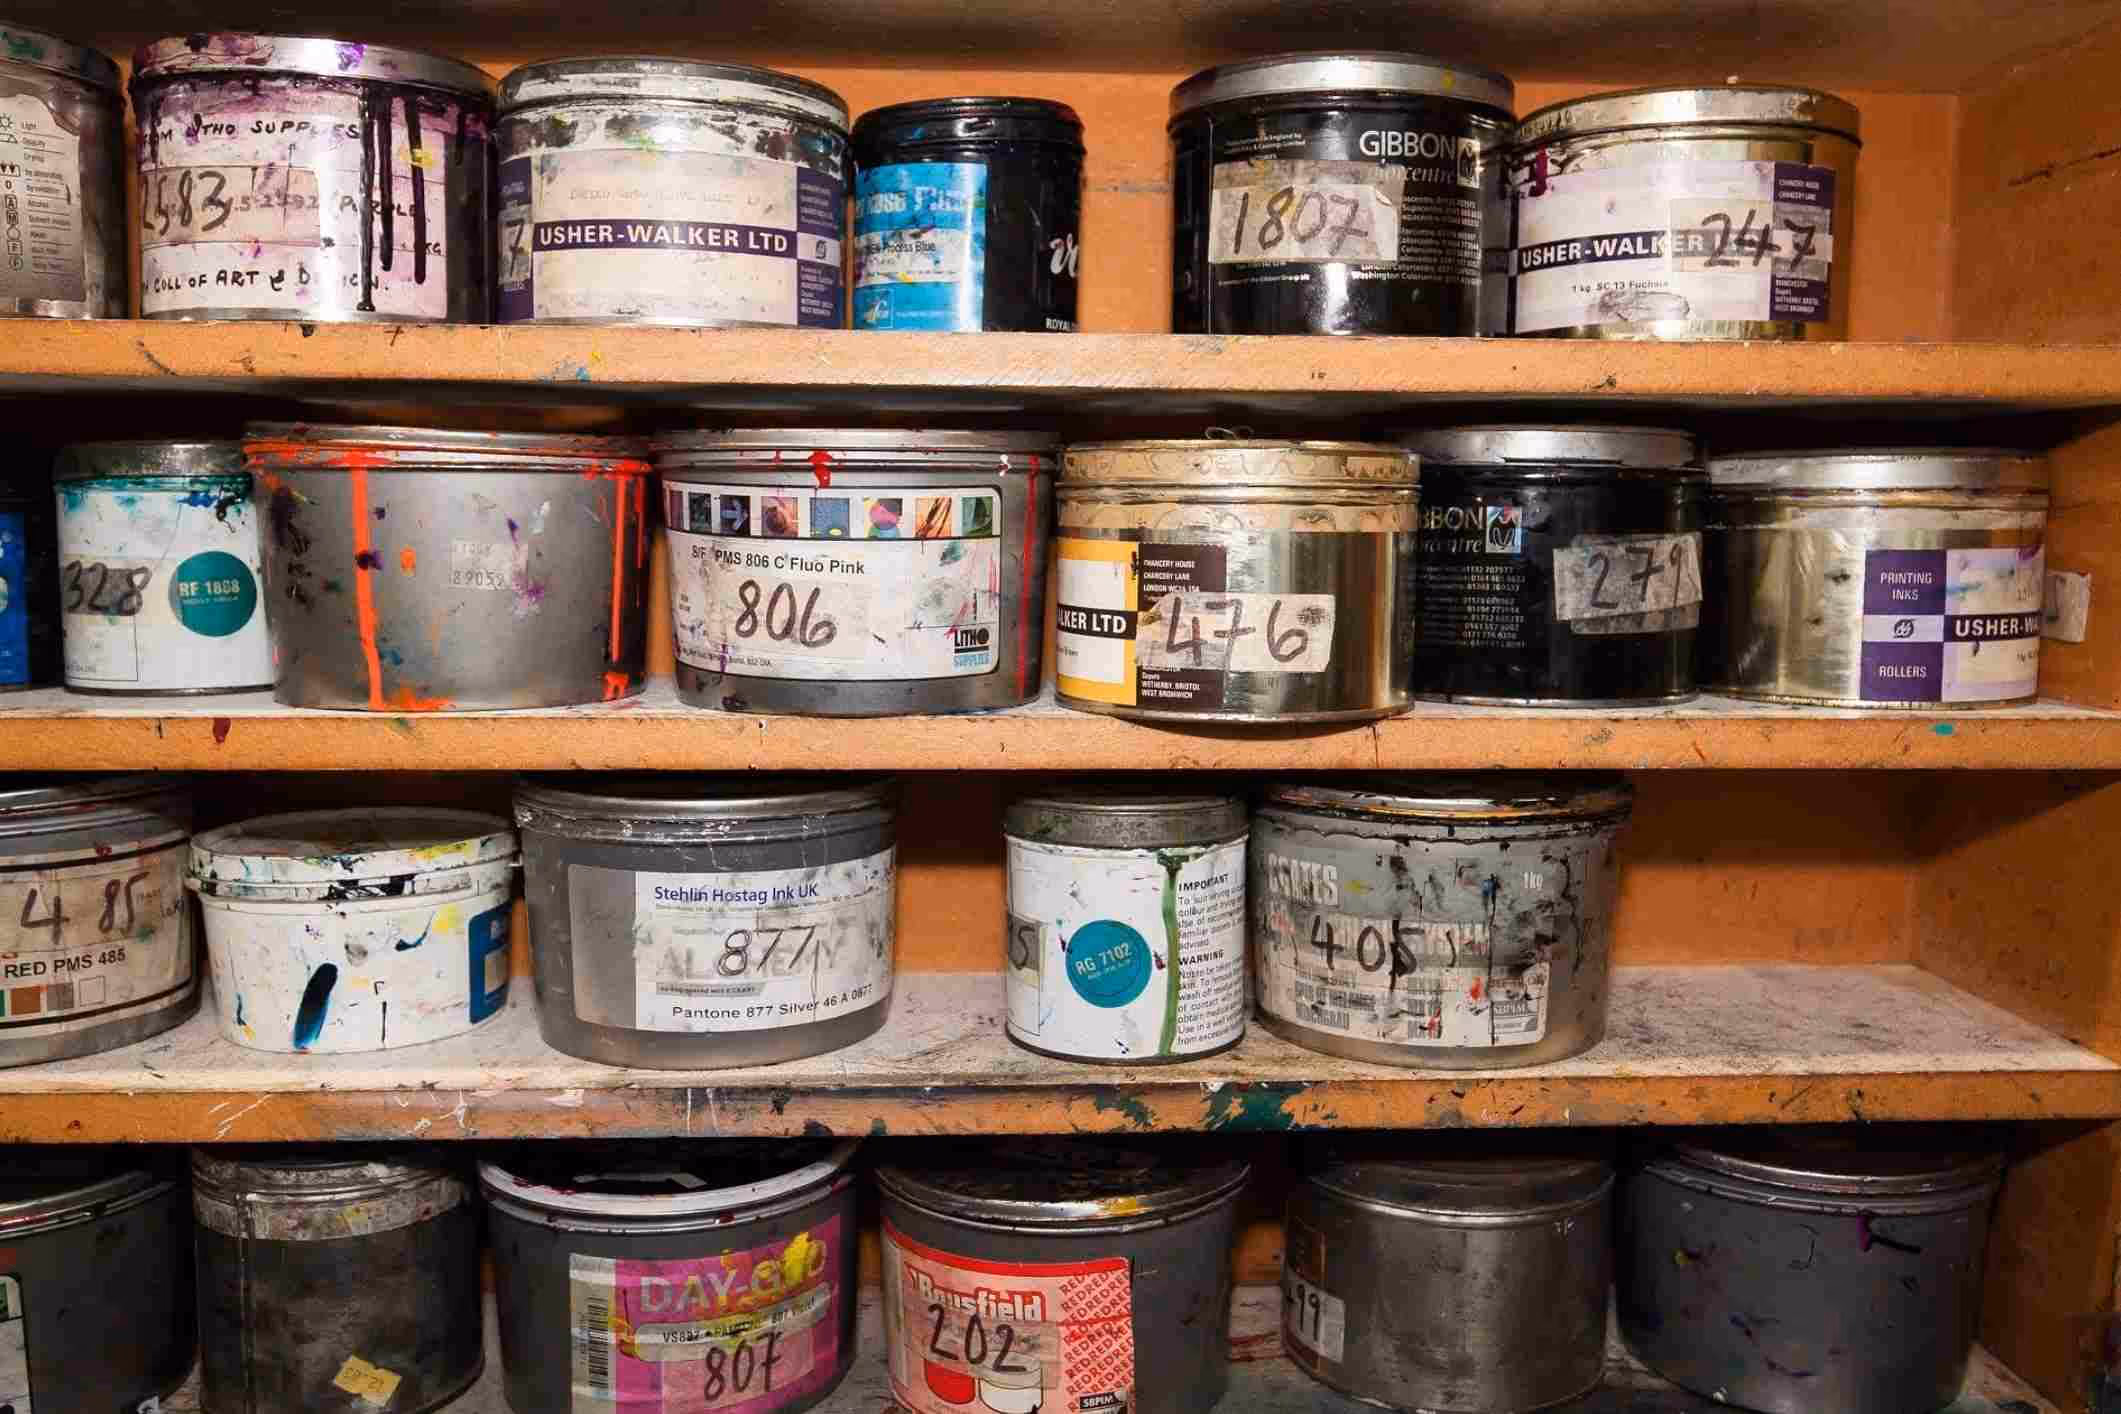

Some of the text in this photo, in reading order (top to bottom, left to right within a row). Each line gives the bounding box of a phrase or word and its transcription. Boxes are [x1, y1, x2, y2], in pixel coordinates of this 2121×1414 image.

[251, 120, 361, 139] SUPPLES
[1359, 130, 1457, 160] GIBBON
[1231, 186, 1369, 256] 1807
[540, 224, 788, 252] USHER-WALKER LTD
[1521, 233, 1704, 269] USHER-WALKER
[1702, 208, 1817, 271] 247
[189, 277, 208, 291] OF
[215, 269, 260, 288] ART
[714, 549, 742, 565] PMS
[745, 553, 770, 569] 806
[774, 556, 785, 569] C
[790, 556, 825, 573] Fluo
[829, 559, 865, 575] Pink
[1587, 543, 1683, 611] 279
[64, 560, 153, 617] 328
[178, 580, 199, 598] RF
[1879, 572, 1932, 585] PRINTING
[1891, 589, 1919, 602] INKS
[735, 579, 838, 648] 806
[1091, 613, 1128, 634] LTD
[1165, 597, 1310, 667] 476
[1878, 665, 1928, 679] ROLLERS
[654, 885, 818, 904] Stehlin Hostag Ink UK
[1522, 871, 1544, 890] 1kg
[717, 925, 817, 978] 877
[1074, 957, 1098, 977] RG
[1097, 942, 1132, 966] 7102
[1310, 914, 1426, 978] 405
[4, 948, 127, 979] RED PMS 485
[672, 1005, 741, 1020] Pantone
[746, 1005, 773, 1018] 877
[779, 1000, 818, 1016] Silver
[823, 994, 838, 1008] 46
[927, 1304, 1027, 1372] 202
[704, 1330, 784, 1401] 807
